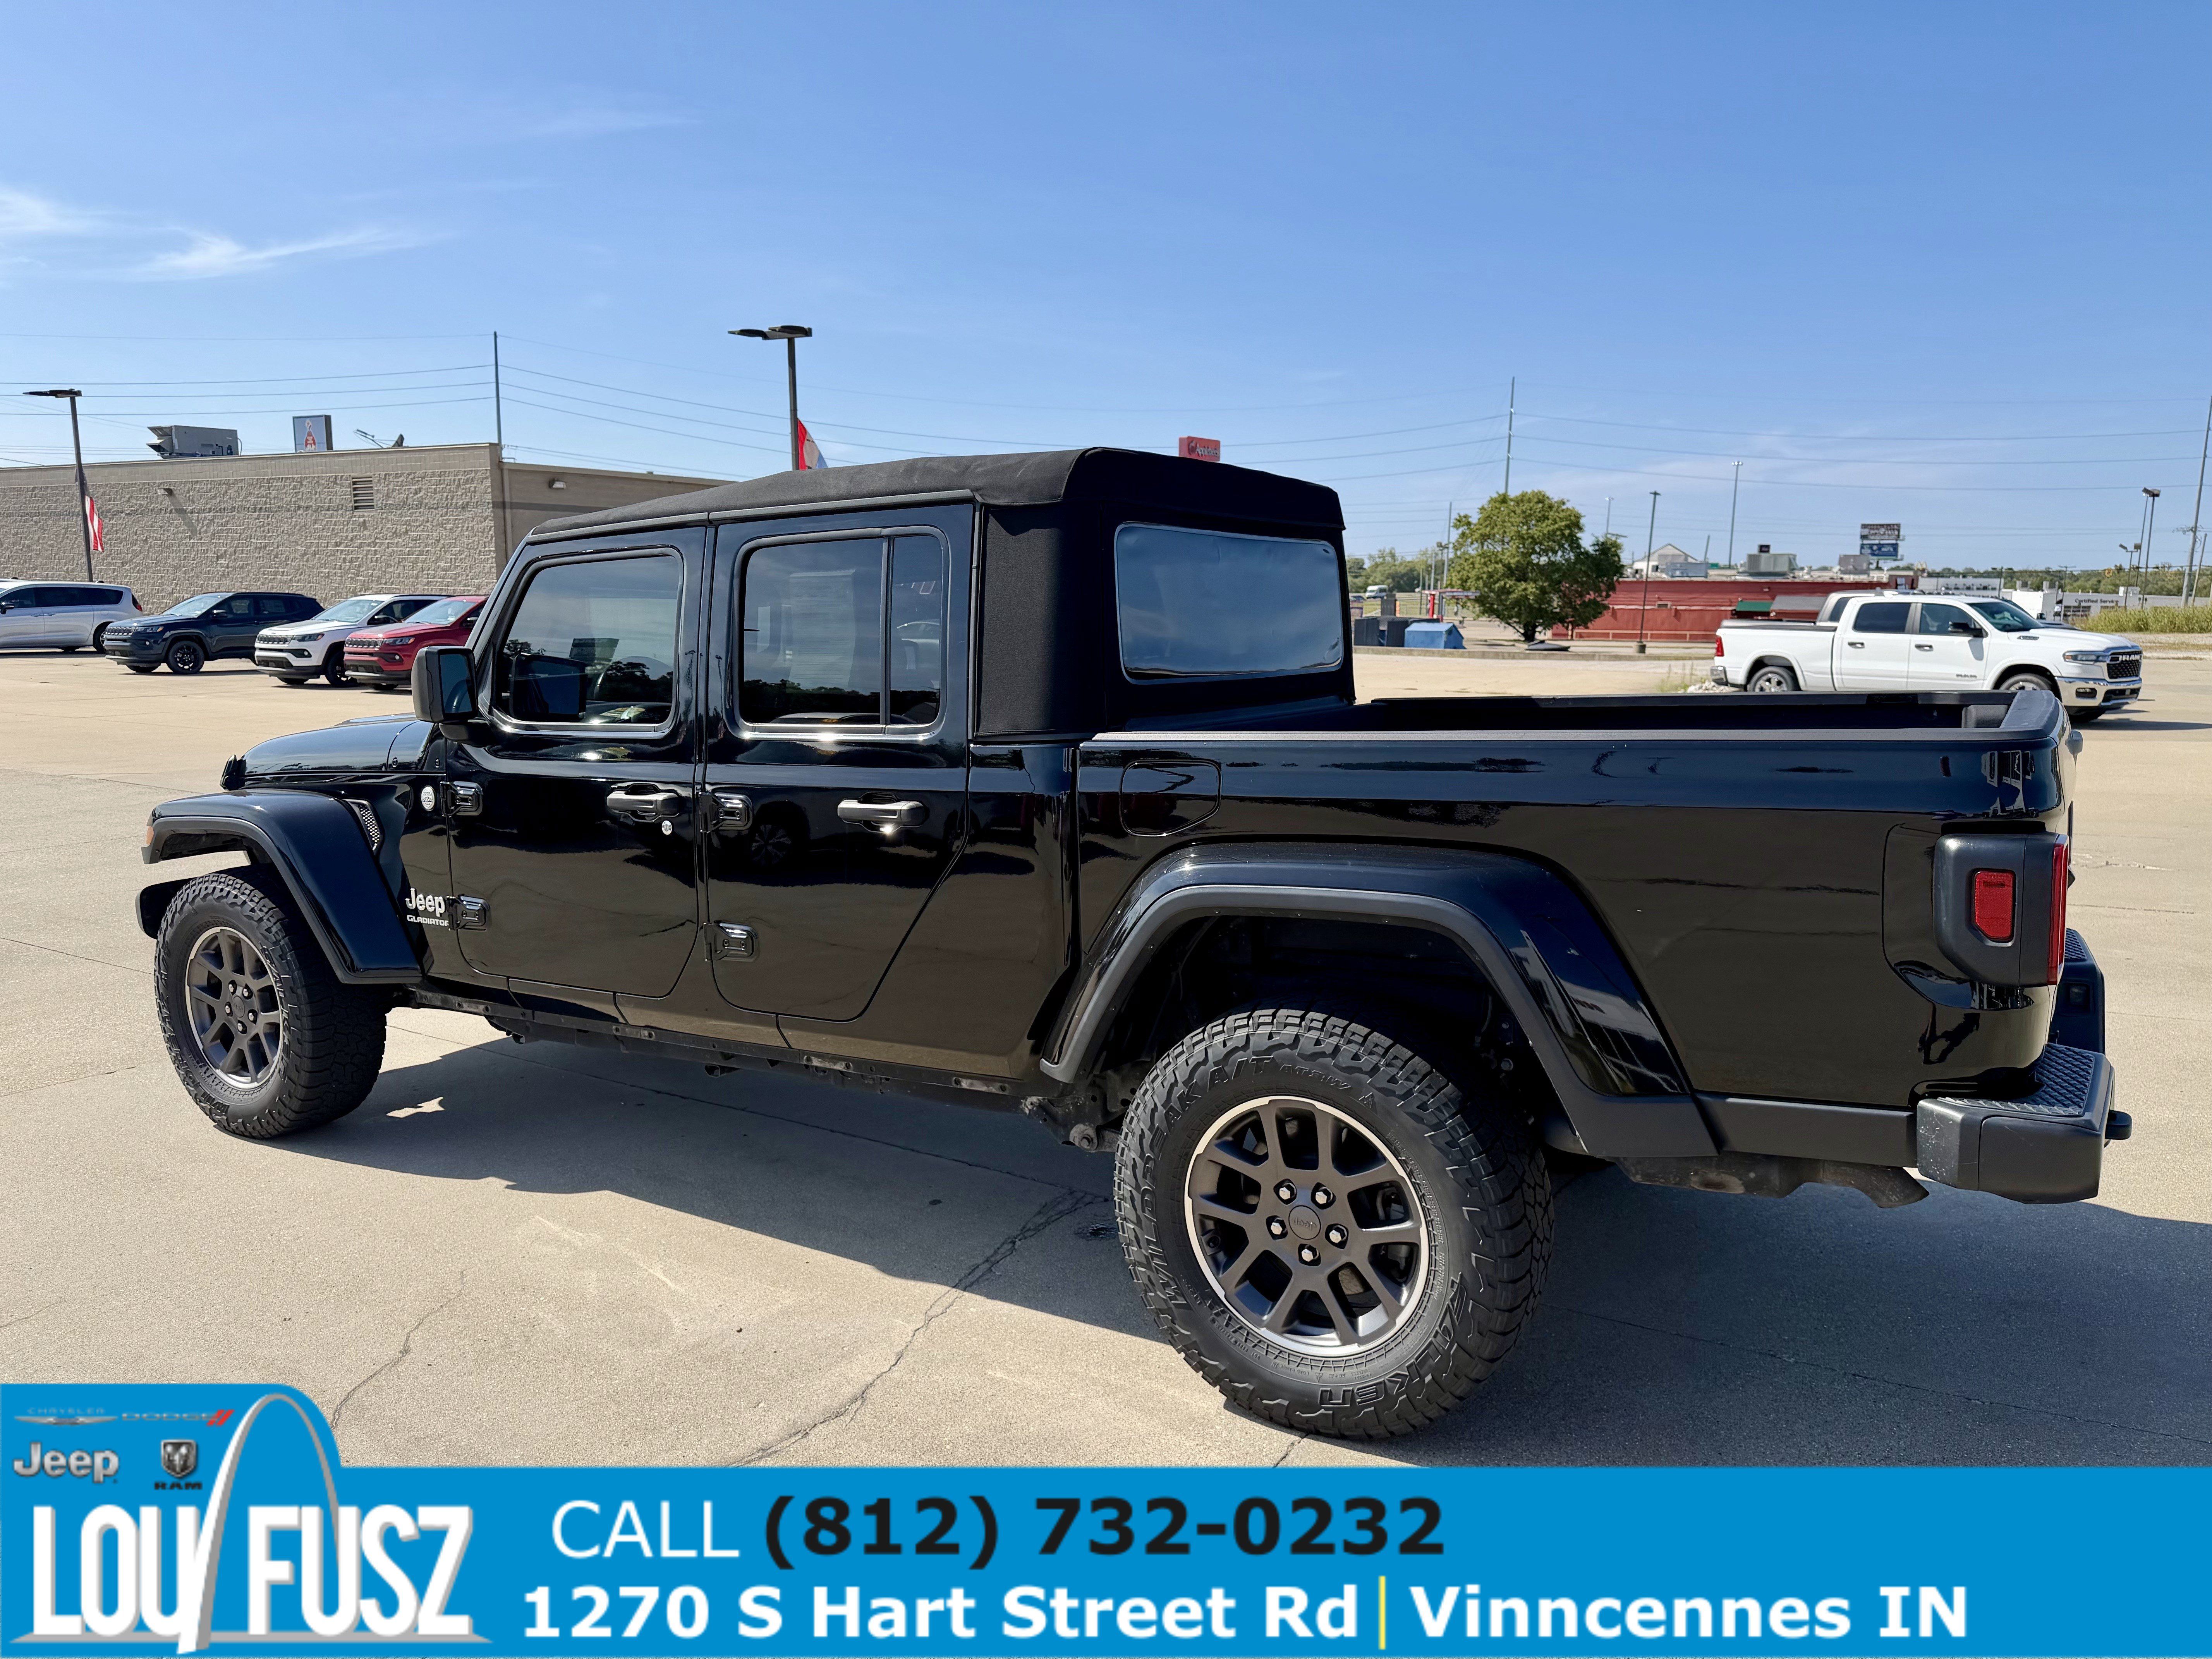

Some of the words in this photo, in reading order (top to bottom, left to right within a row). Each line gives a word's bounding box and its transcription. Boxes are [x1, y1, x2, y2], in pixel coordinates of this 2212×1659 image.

[405, 888, 445, 917] Jeep
[407, 914, 449, 926] GLADIATOR
[1140, 1079, 1201, 1304] WILDPEAK
[1318, 1272, 1467, 1407] FALKEN
